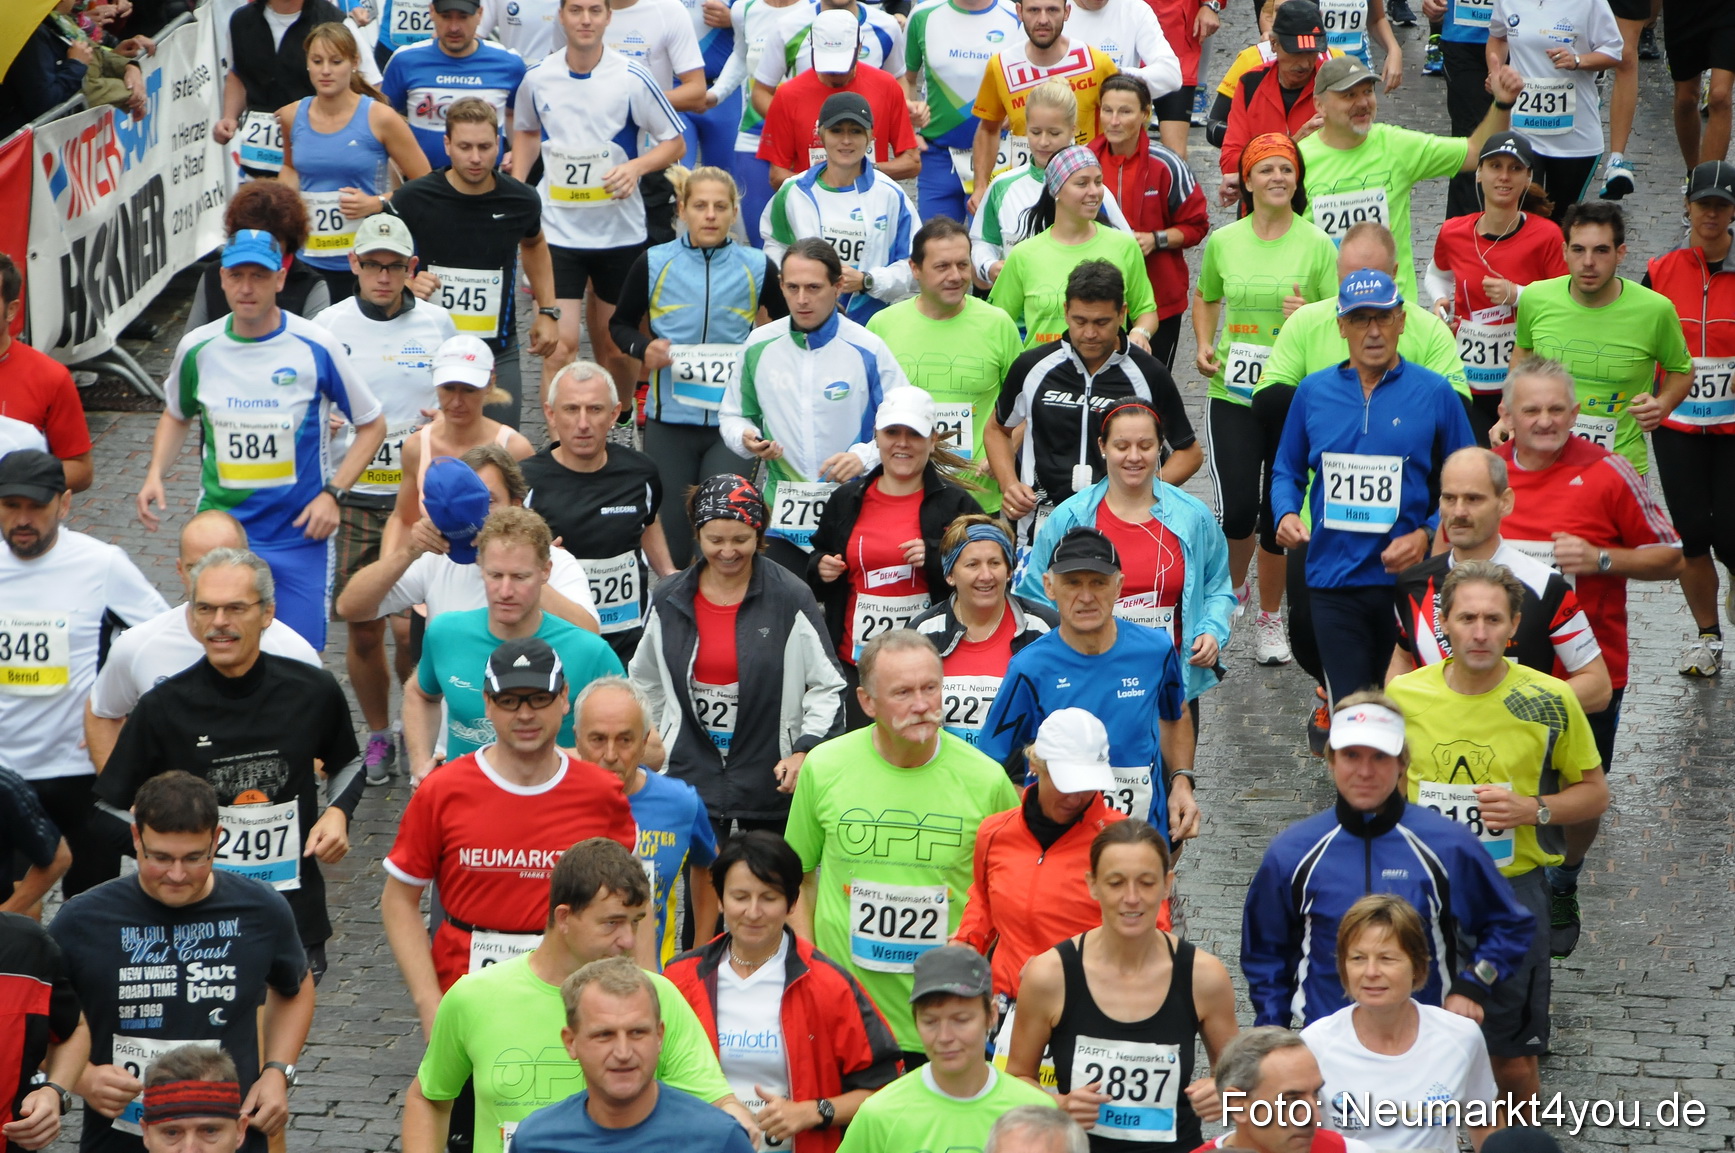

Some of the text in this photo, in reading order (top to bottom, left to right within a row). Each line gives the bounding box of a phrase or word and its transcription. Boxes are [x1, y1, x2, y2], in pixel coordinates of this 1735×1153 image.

[948, 49, 993, 60] Michael
[1518, 92, 1567, 113] 2431
[1524, 118, 1561, 127] Adelheid
[565, 163, 591, 185] 27
[569, 190, 591, 201] Jens
[315, 208, 343, 231] 26
[454, 276, 490, 284] Neumarkt
[1346, 279, 1382, 293] ITALIA
[441, 285, 487, 312] 545
[1460, 338, 1515, 365] 2313
[1467, 369, 1508, 381] Susanne
[226, 397, 280, 408] Thomas
[1692, 406, 1712, 418] Anja
[228, 433, 279, 460] 584
[367, 470, 402, 482] Robert
[1330, 473, 1392, 502] 2158
[1345, 509, 1370, 520] Hans
[590, 562, 627, 575] Neumarkt
[588, 572, 633, 605] 526
[857, 602, 920, 613] PARTL Neumarkt
[7, 670, 40, 683] Bernd
[1121, 678, 1139, 687] TSG
[1117, 688, 1146, 698] Laaber
[1420, 790, 1447, 800] PARTL
[238, 813, 282, 826] Neumarkt
[214, 825, 289, 861] 2497
[853, 886, 932, 904] PARTL Neumarkt
[859, 902, 938, 940] 2022
[121, 940, 232, 964] West Coast
[473, 942, 505, 954] PARTL
[872, 944, 919, 961] Werner
[119, 964, 177, 981] NEW WAVES
[118, 982, 178, 1000] BOARD TIME
[118, 1003, 163, 1019] SRF 1969
[115, 1043, 148, 1058] PARTL
[1077, 1045, 1165, 1064] PARTL Neumarkt
[1084, 1063, 1172, 1104] 2837
[1105, 1109, 1141, 1127] Petra
